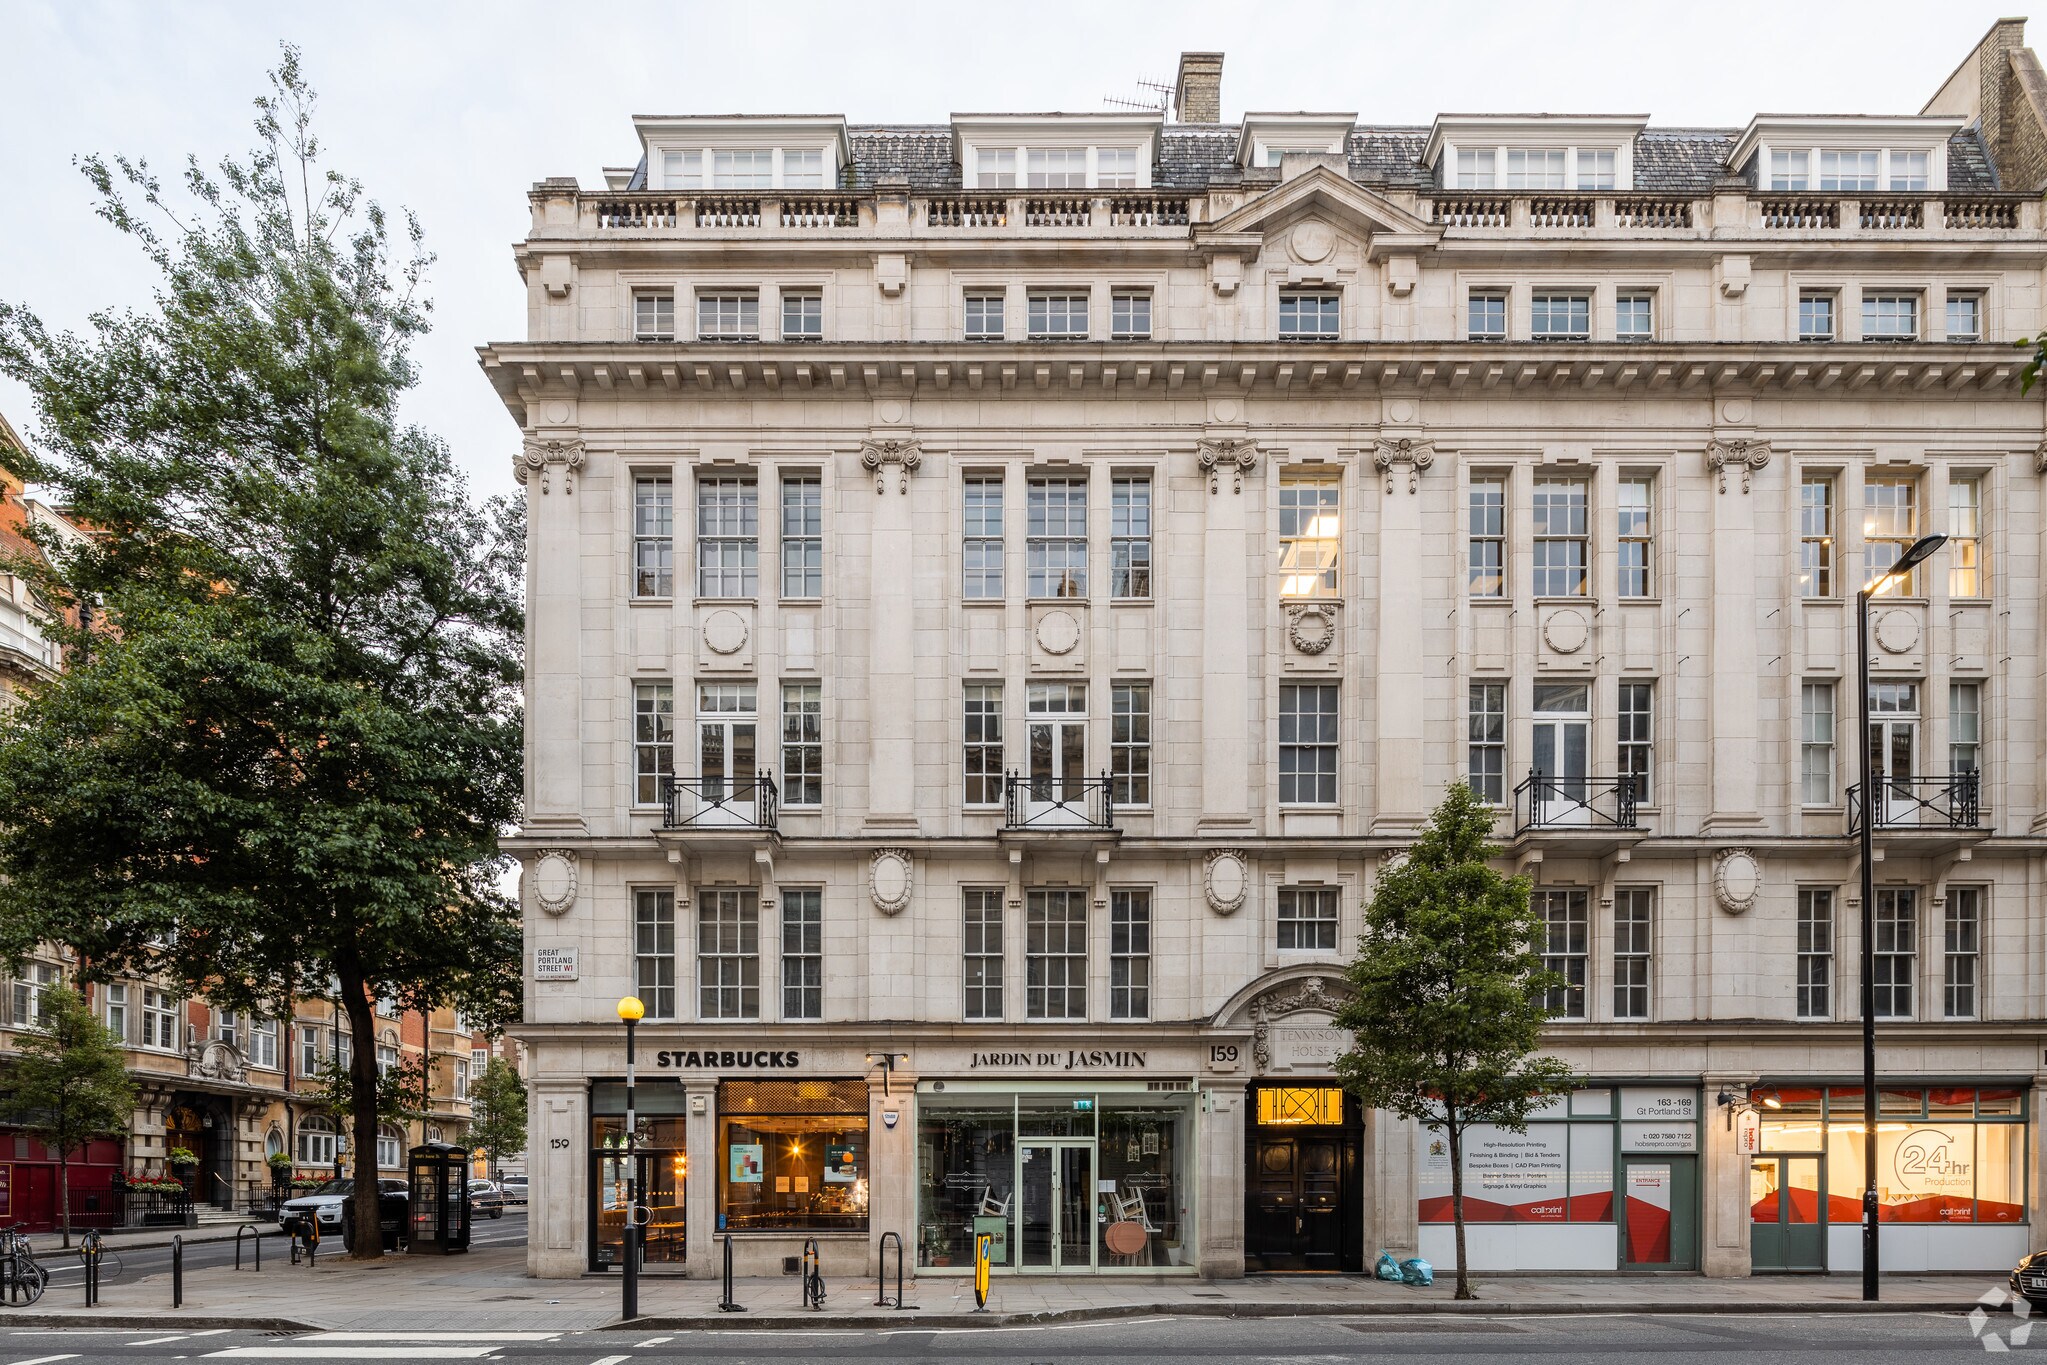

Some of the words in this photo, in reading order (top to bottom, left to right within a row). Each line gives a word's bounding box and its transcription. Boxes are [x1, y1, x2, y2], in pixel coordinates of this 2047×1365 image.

[1281, 1031, 1342, 1040] TENNYSON
[1210, 1045, 1239, 1062] 159
[1292, 1046, 1330, 1056] HOUSE
[658, 1051, 799, 1067] STARBUCKS
[970, 1053, 1031, 1068] JARDIN
[1037, 1054, 1060, 1066] DU
[1065, 1050, 1147, 1069] JASMIN
[550, 1139, 569, 1149] 159
